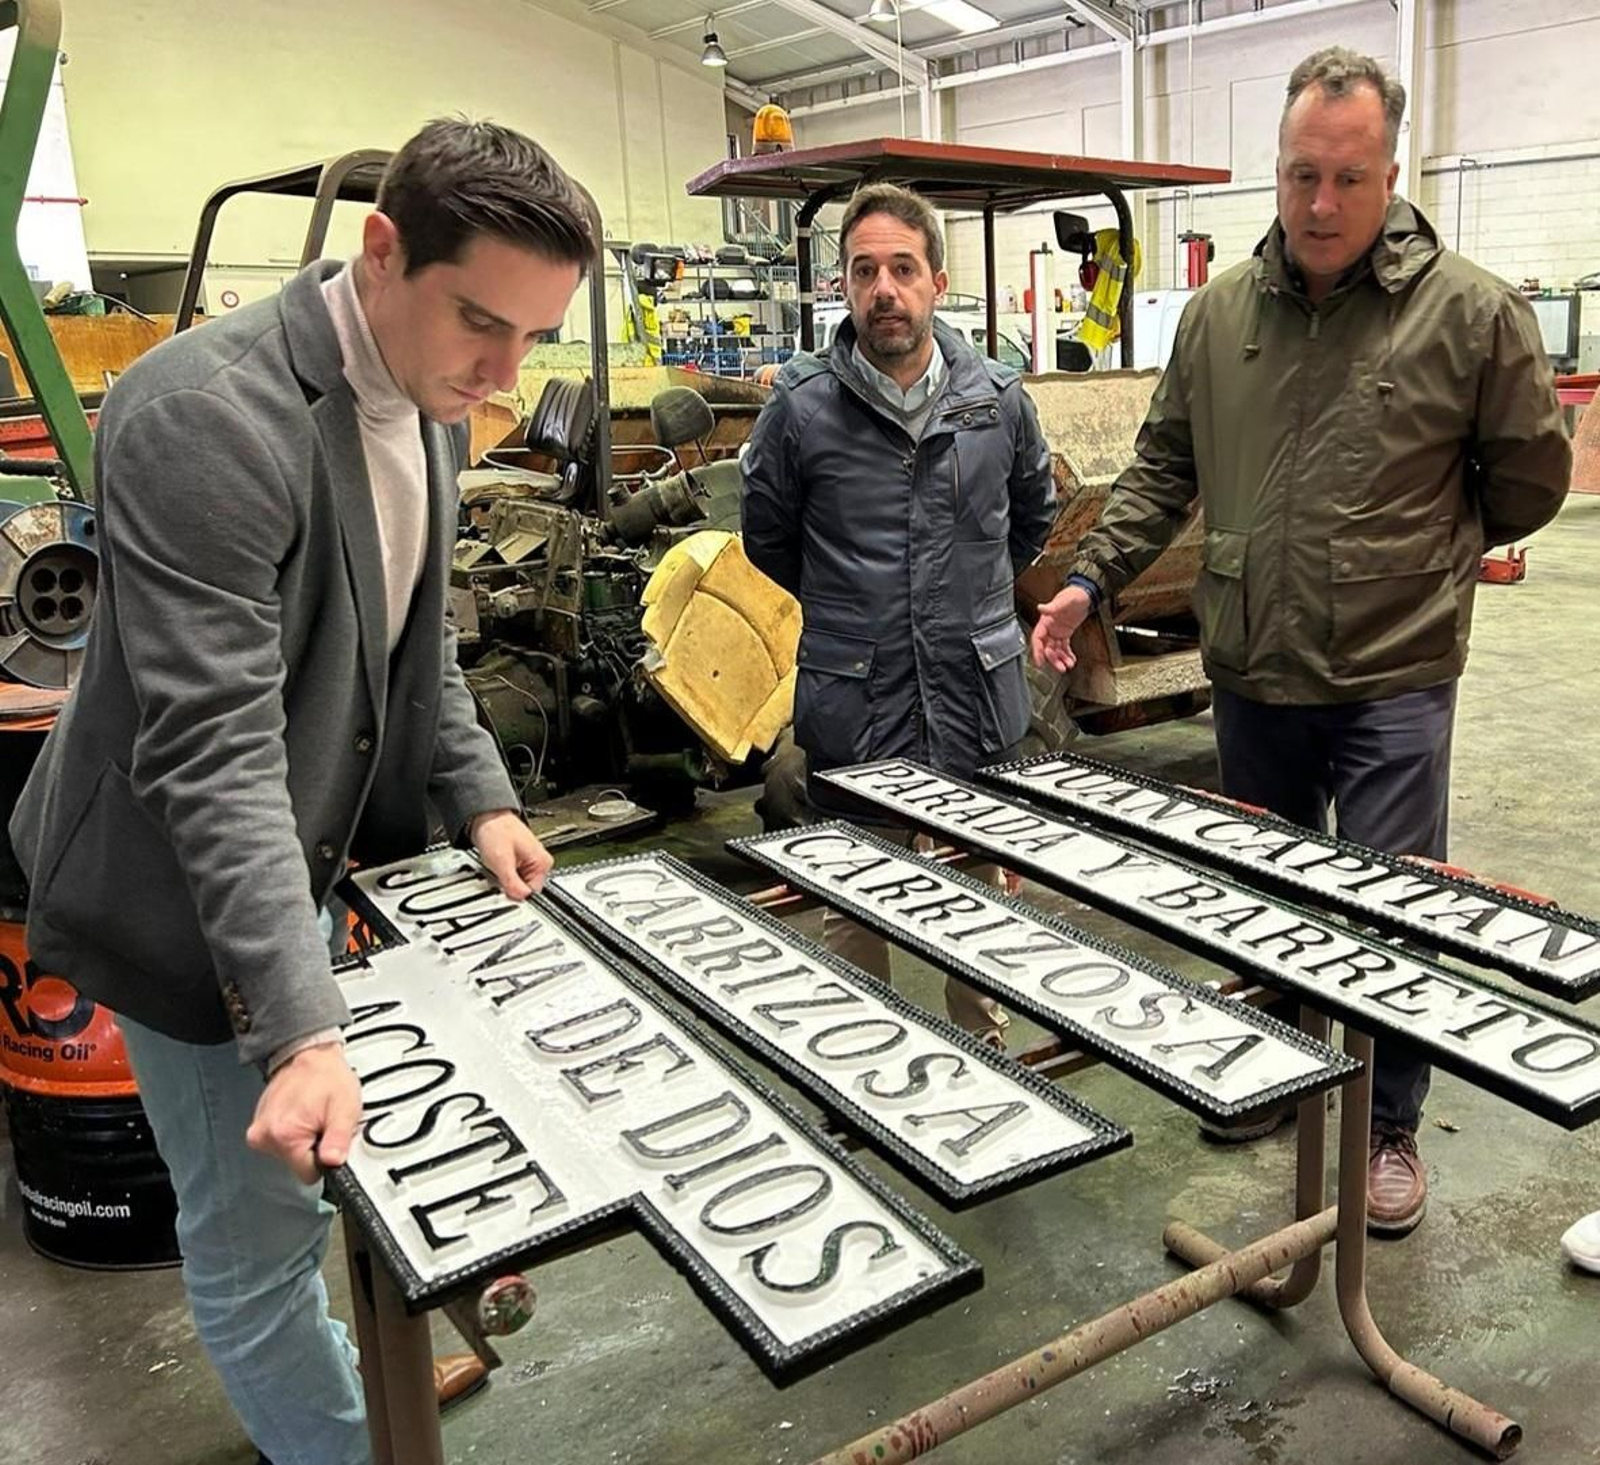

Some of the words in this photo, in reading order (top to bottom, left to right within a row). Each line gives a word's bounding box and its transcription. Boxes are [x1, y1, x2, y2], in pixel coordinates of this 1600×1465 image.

[783, 835, 1266, 1081] CARRIZOSA
[847, 765, 1080, 852] PARADA
[1079, 853, 1162, 877] Y
[1138, 881, 1600, 1073] BARRETO
[1018, 763, 1206, 821] JUAN
[1195, 821, 1600, 962] CAPITAN
[3, 1034, 54, 1062] Racing
[377, 864, 586, 1007] JUANA
[525, 998, 696, 1104] DE
[620, 1090, 899, 1293] DIOS
[585, 869, 1030, 1156] CARRIZOSA
